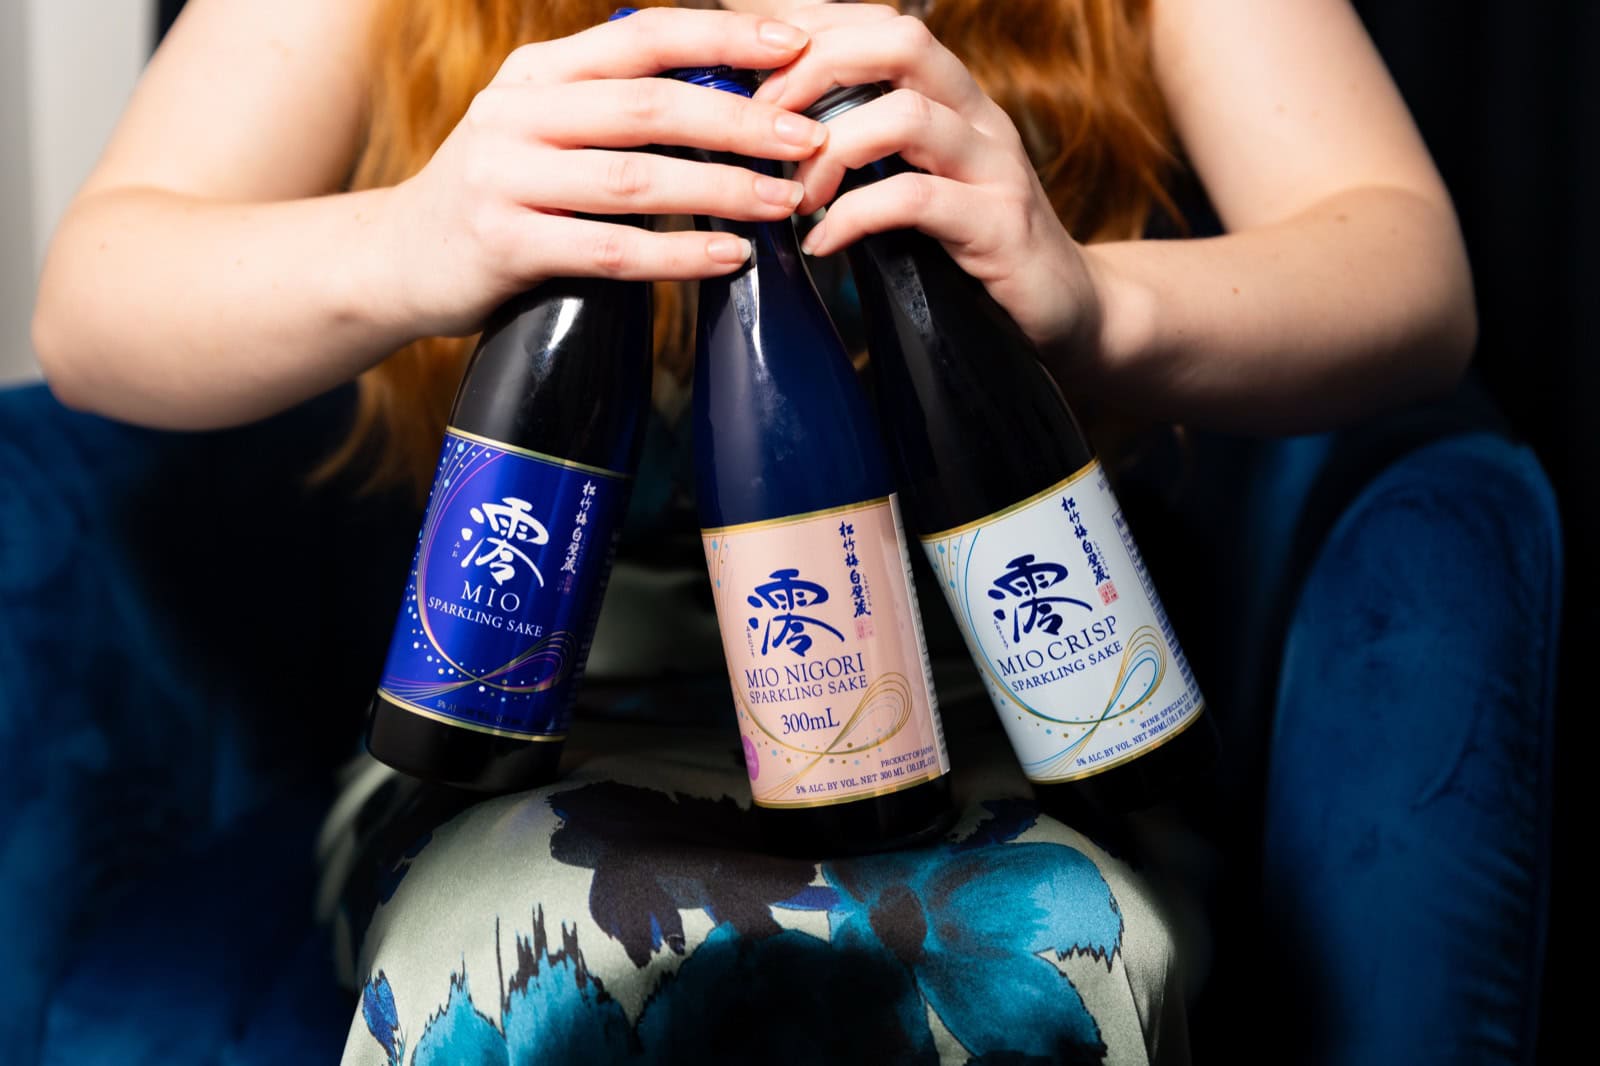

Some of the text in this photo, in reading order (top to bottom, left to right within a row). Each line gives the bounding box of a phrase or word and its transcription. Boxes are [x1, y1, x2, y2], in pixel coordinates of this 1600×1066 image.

[460, 580, 520, 612] MIO
[427, 595, 543, 638] SPARKLING SAKE
[997, 649, 1044, 677] MIO
[1047, 615, 1117, 661] CRISP
[744, 652, 865, 688] MIO NIGORI
[1011, 640, 1123, 692] SPARKLING SAKE
[749, 674, 868, 704] SPARKLING SAKE
[780, 707, 840, 735] 300mL
[1139, 712, 1161, 729] WINE
[1160, 691, 1189, 718] SPECIALTY
[880, 754, 912, 768] PRODUCT
[1076, 757, 1087, 767] 5%
[1088, 751, 1105, 763] ALC.
[1104, 746, 1115, 758] BY
[1115, 740, 1133, 752] VOL.
[1133, 731, 1149, 745] NET
[795, 784, 807, 795] 5%
[808, 782, 826, 793] ALC.
[827, 780, 839, 791] BY
[840, 778, 859, 789] VOL.
[860, 773, 878, 785] NET
